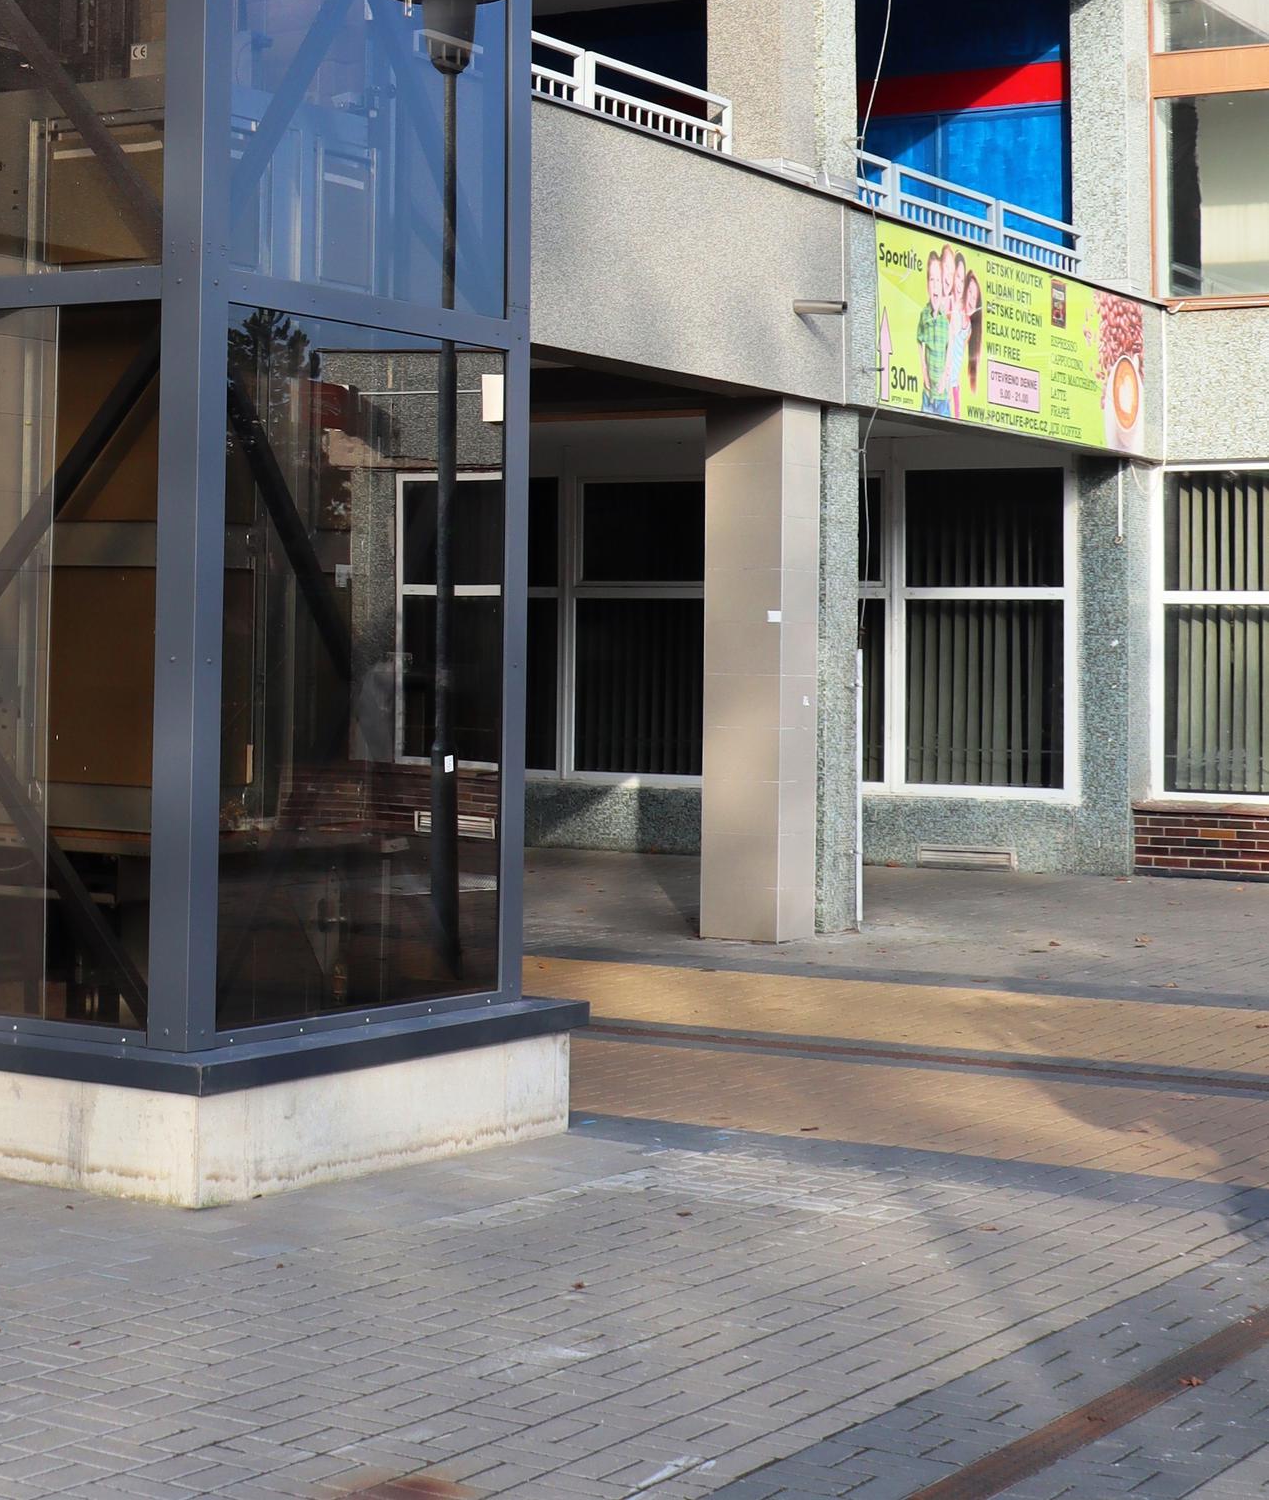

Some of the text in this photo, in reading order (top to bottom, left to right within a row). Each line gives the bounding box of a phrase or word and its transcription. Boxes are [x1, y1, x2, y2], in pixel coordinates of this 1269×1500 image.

[879, 242, 923, 272] Sportlife
[1016, 269, 1043, 289] KOUTEK
[986, 321, 1036, 345] RELAX COFFEE
[986, 341, 1021, 361] WIFI FREE
[891, 365, 918, 392] 30m
[1051, 370, 1066, 384] LATTE
[1051, 387, 1067, 401] LATTE
